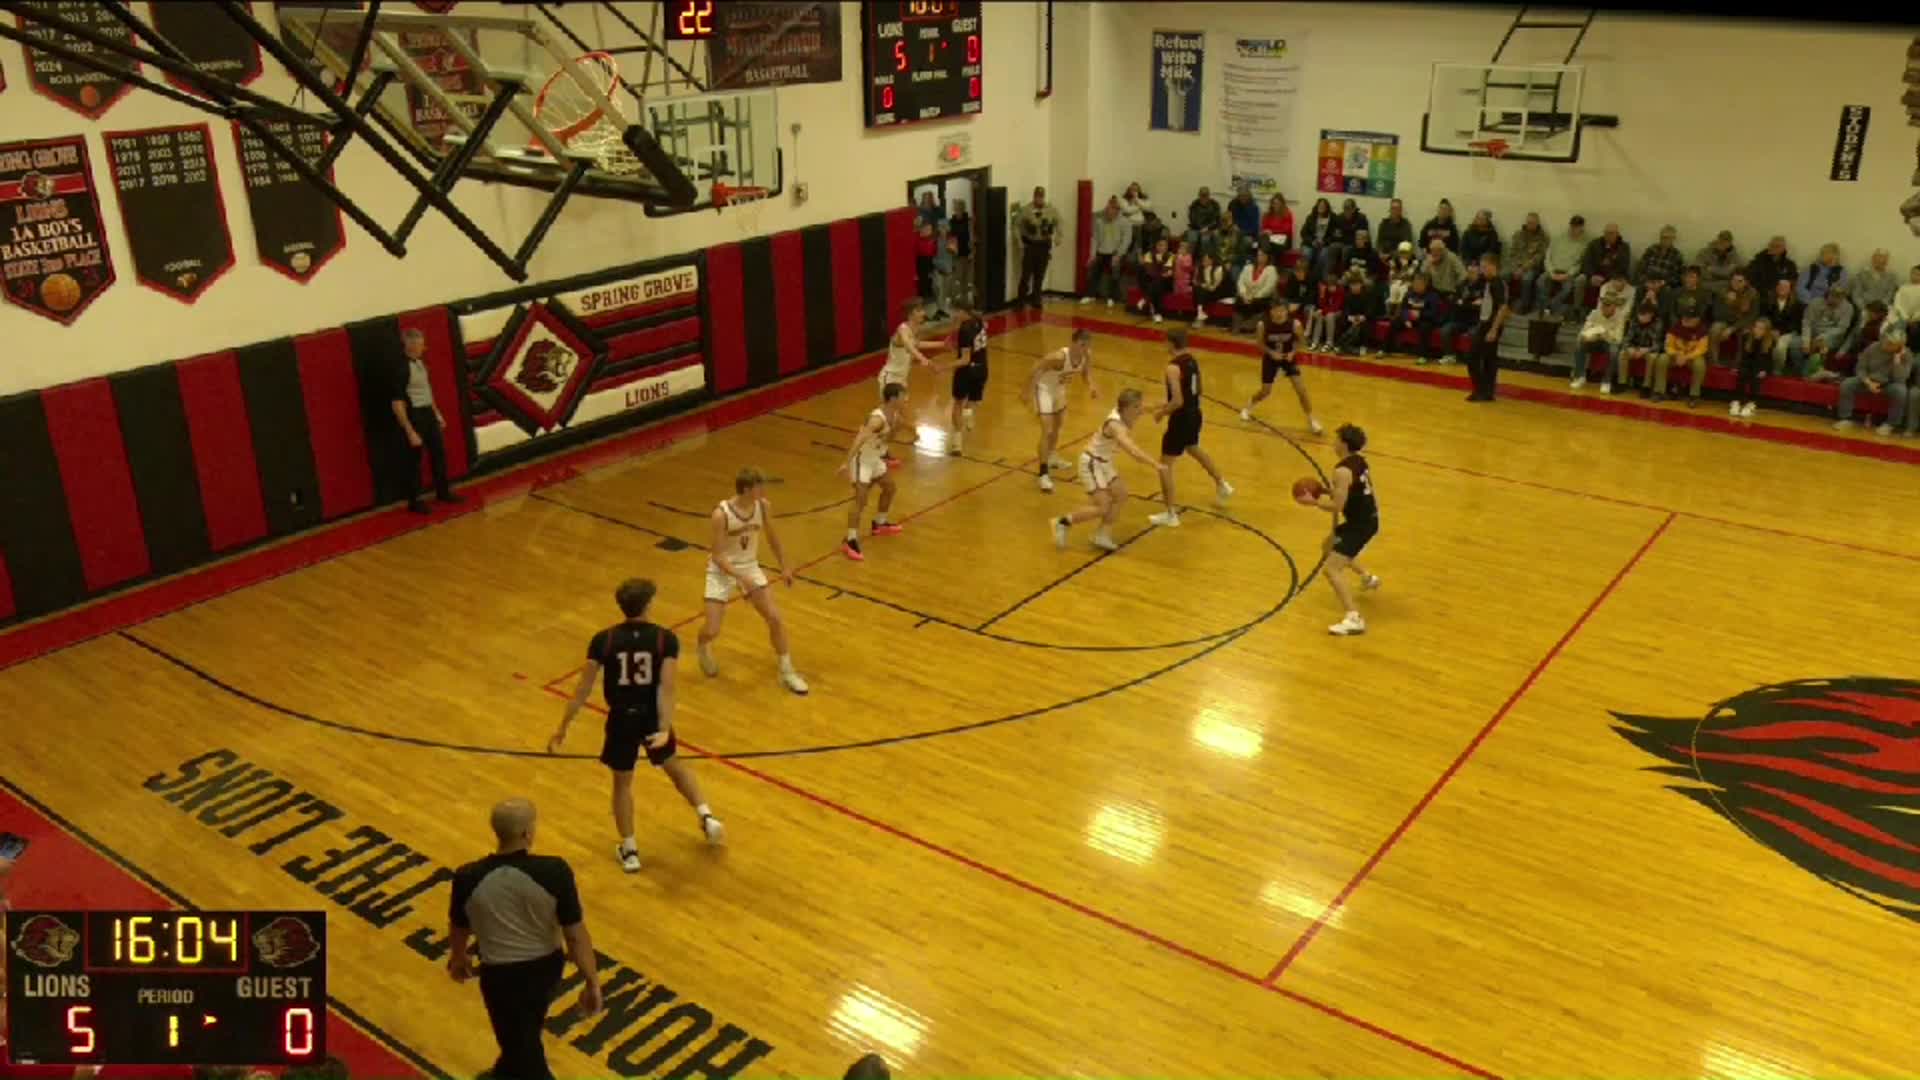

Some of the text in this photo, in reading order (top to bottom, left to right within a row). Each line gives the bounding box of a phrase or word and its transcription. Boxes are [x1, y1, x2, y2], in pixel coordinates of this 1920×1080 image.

[679, 1, 712, 34] 22
[894, 40, 907, 71] 5
[967, 35, 979, 63] 0
[1153, 34, 1202, 49] Refuel
[1162, 50, 1197, 64] With
[1160, 65, 1193, 79] Milk
[11, 217, 83, 242] 1A BOYS
[1, 231, 98, 261] BASKETBALL
[580, 271, 694, 312] SPRING GROVE
[624, 380, 670, 409] LIONS
[616, 651, 653, 686] 13
[141, 748, 345, 857] LIONS
